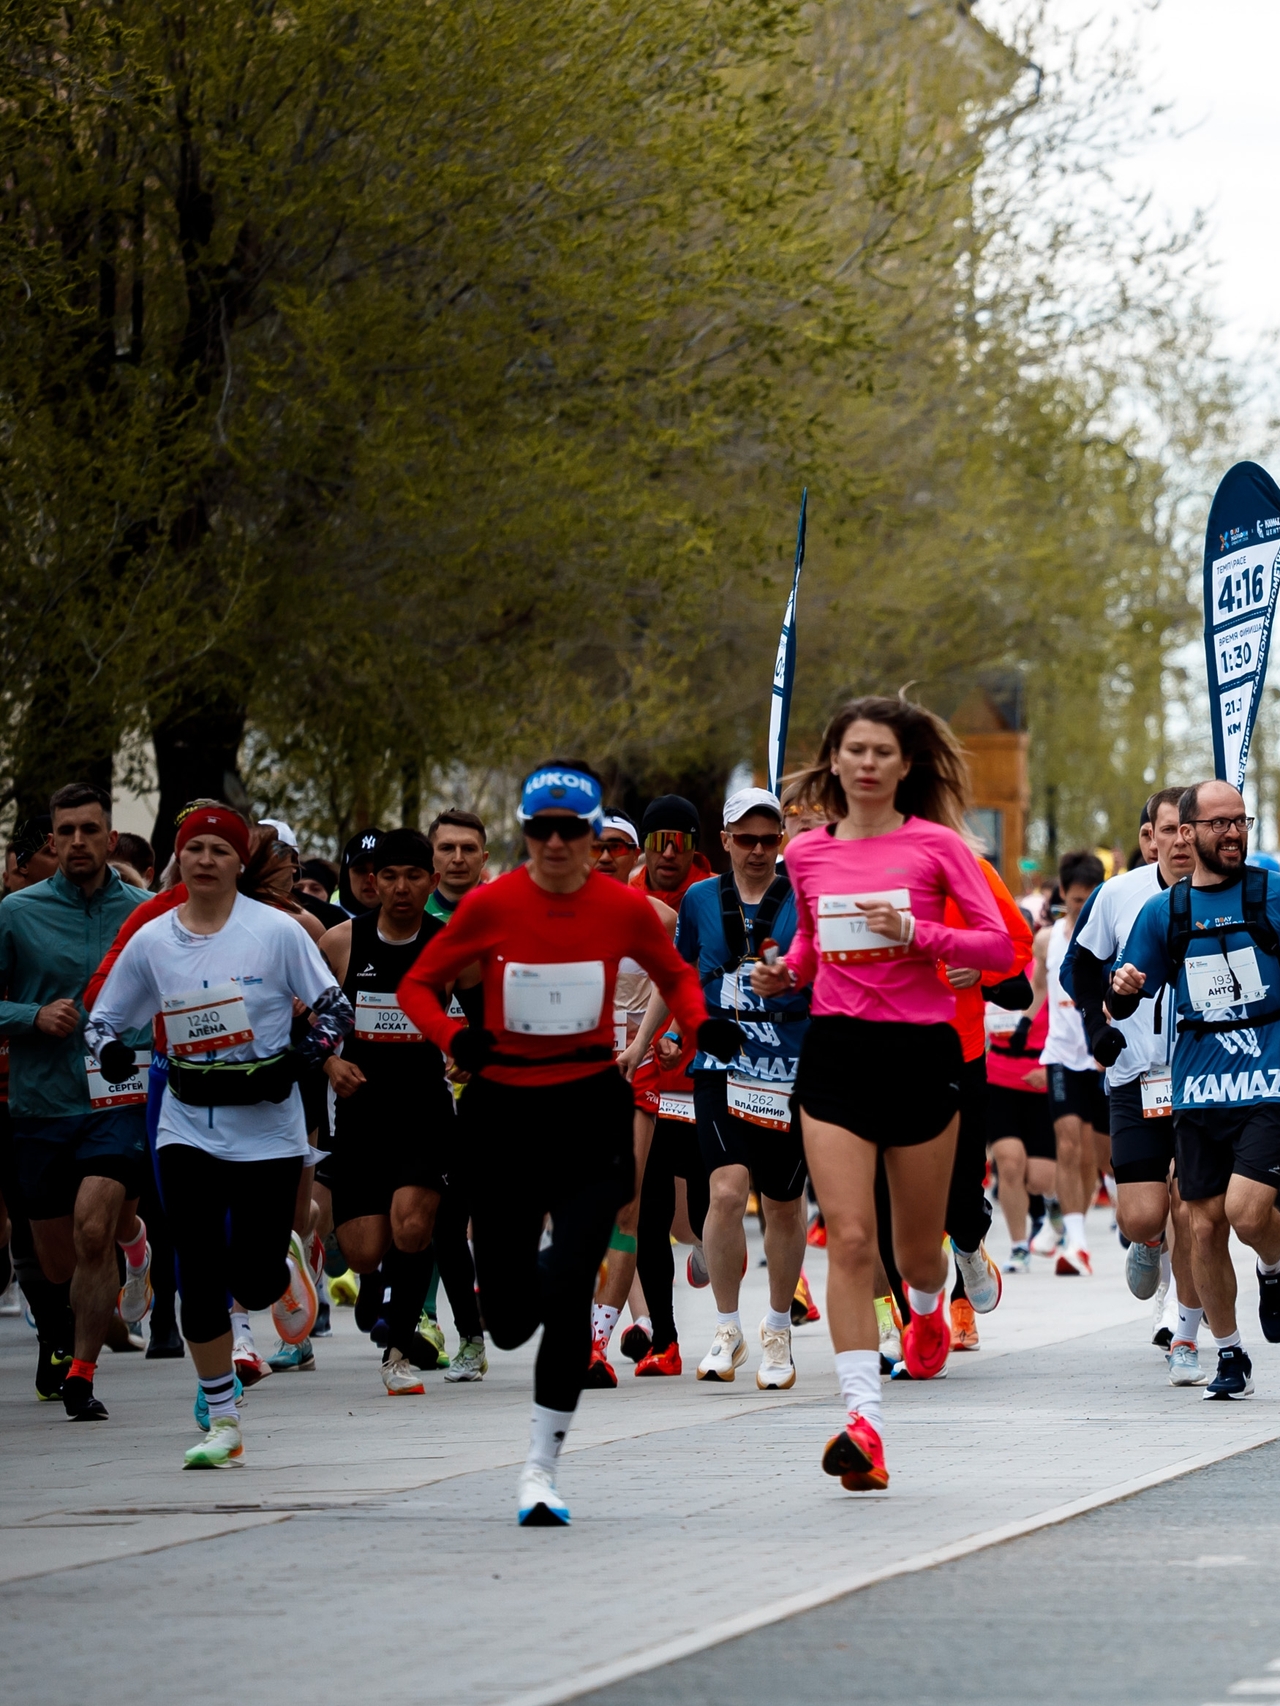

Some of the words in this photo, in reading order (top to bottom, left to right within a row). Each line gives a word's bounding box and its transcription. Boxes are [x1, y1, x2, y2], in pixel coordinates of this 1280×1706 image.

[1218, 564, 1265, 613] 4:16
[1218, 631, 1238, 647] ВРЕМЯ
[1220, 641, 1252, 674] 1:30
[1252, 633, 1268, 695] КАЖДОМ
[1212, 973, 1233, 986] 193
[1208, 983, 1243, 997] АНТО
[378, 1011, 406, 1022] 1007
[449, 1006, 464, 1015] СЕ
[187, 1010, 220, 1028] 1240
[188, 1023, 228, 1039] АЛЁНА
[374, 1022, 409, 1031] АСХАТ
[108, 1080, 144, 1093] СЕРГЕЙ
[661, 1100, 687, 1110] 1077
[747, 1093, 774, 1107] 1262
[659, 1106, 689, 1116] АРТУР
[734, 1099, 785, 1117] ВЛАДИМИР
